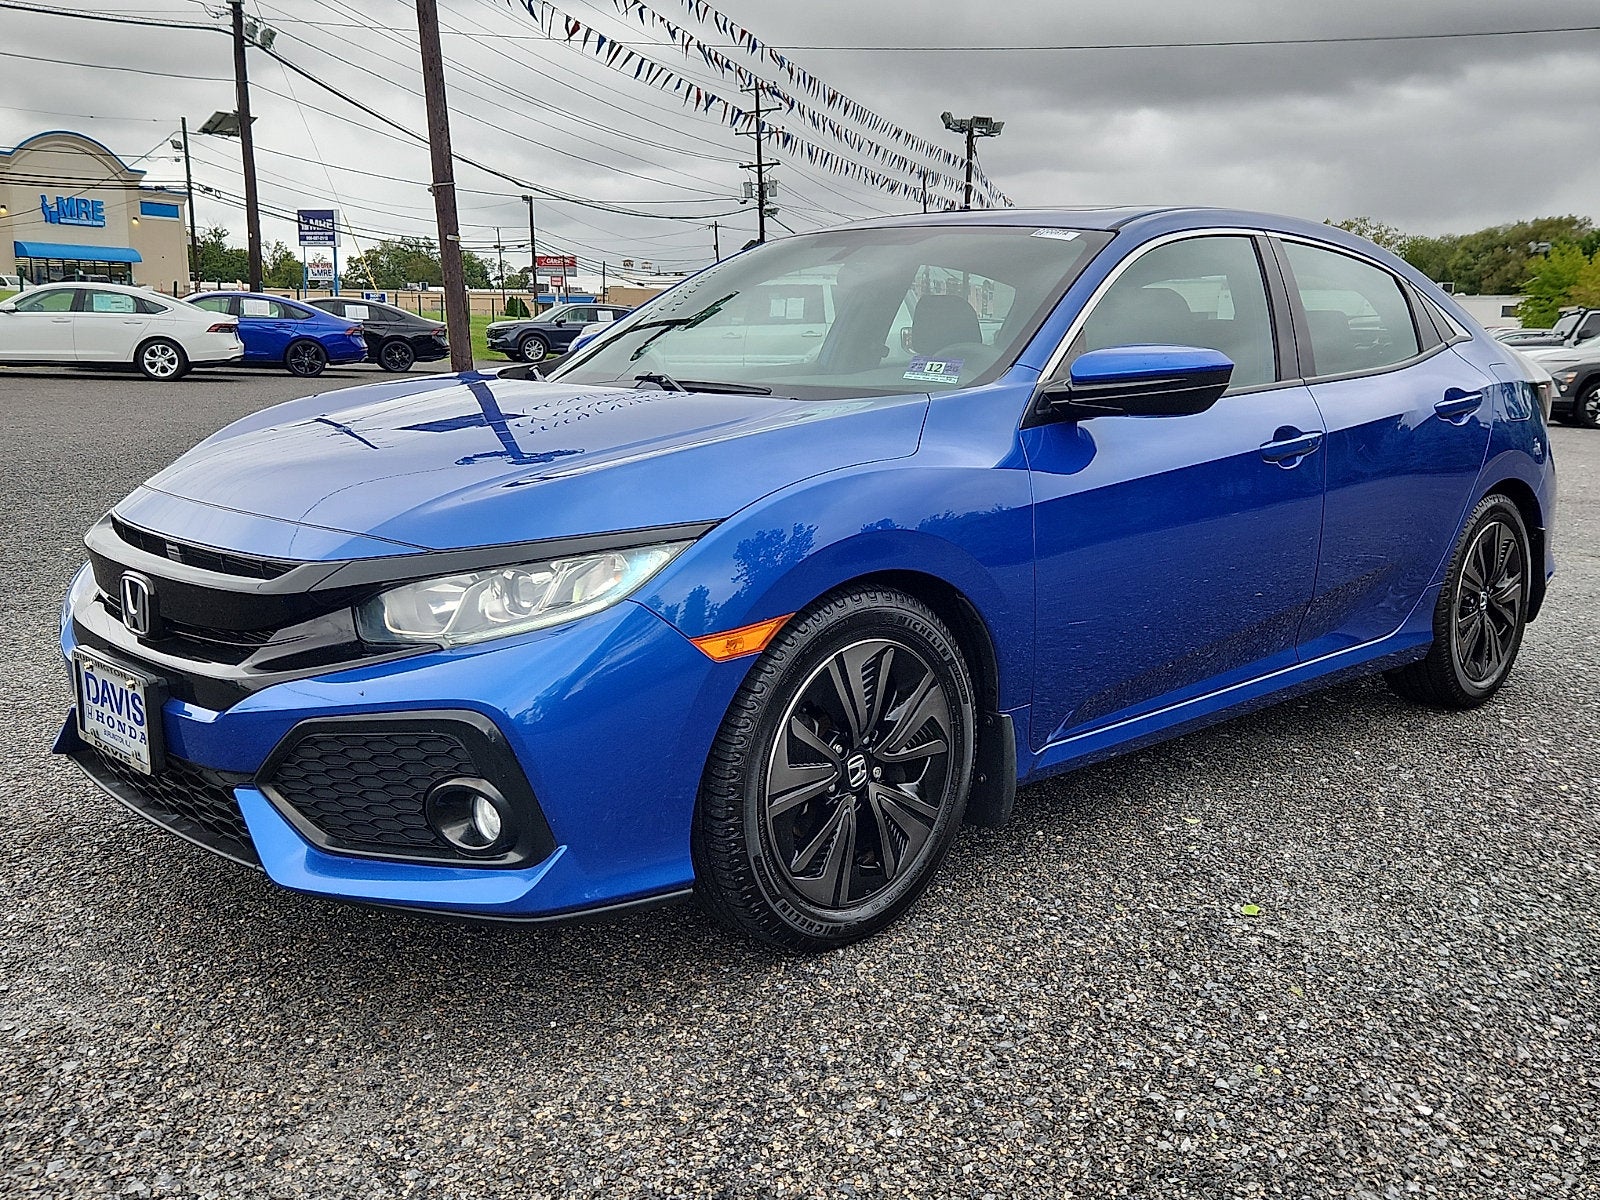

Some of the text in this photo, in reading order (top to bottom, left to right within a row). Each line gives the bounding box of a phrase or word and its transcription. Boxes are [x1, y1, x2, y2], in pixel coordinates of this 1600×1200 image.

[56, 196, 105, 222] MRE
[317, 269, 333, 277] MRE
[926, 363, 943, 373] 12
[897, 615, 953, 662] MICHELIN
[84, 671, 145, 727] DAVIS
[95, 709, 147, 746] HONDA
[94, 739, 132, 764] DAVIS
[778, 899, 843, 936] MICHELIN
